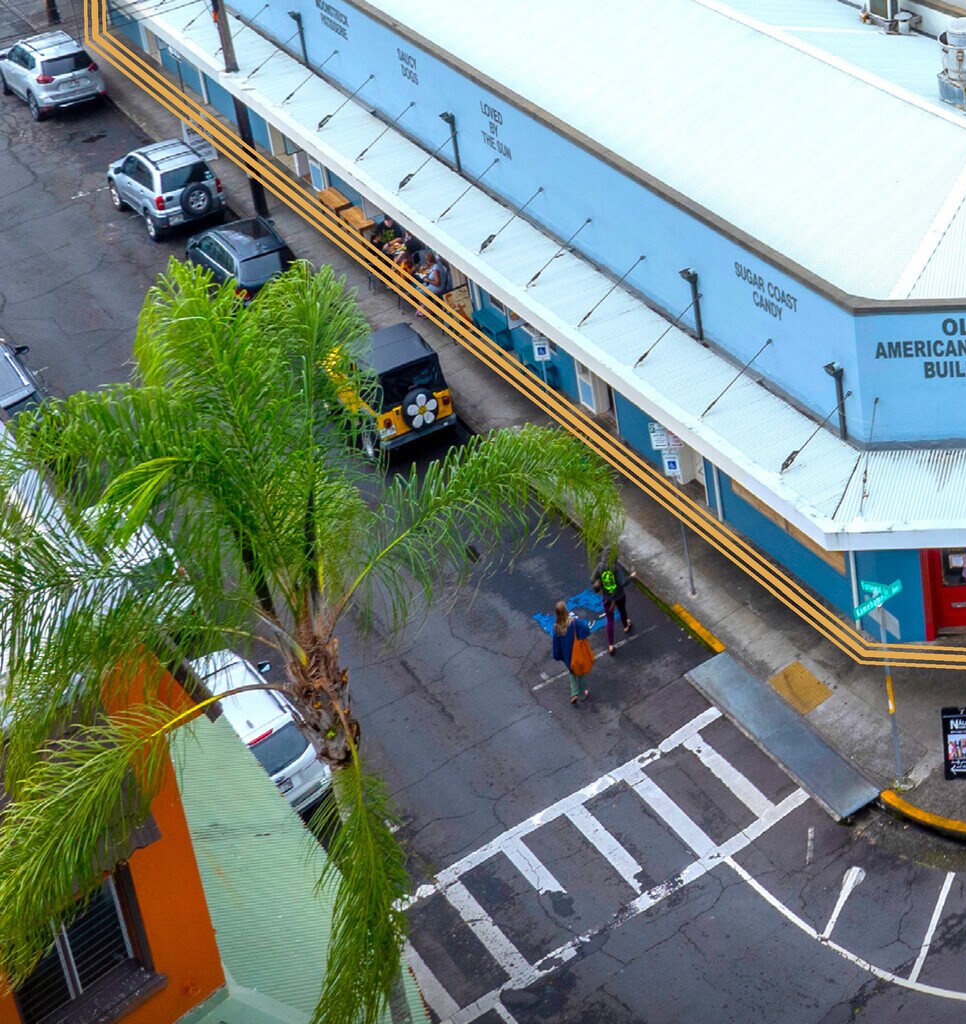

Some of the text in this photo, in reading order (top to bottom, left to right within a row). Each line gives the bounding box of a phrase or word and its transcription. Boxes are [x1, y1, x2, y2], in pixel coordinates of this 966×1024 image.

[397, 48, 417, 70] SAUCY
[401, 65, 419, 86] DOGS
[480, 101, 504, 125] LOVED
[489, 122, 499, 137] BY
[481, 130, 512, 161] THE SUN
[734, 261, 798, 313] SUGAR COAST
[752, 291, 783, 321] CANDY
